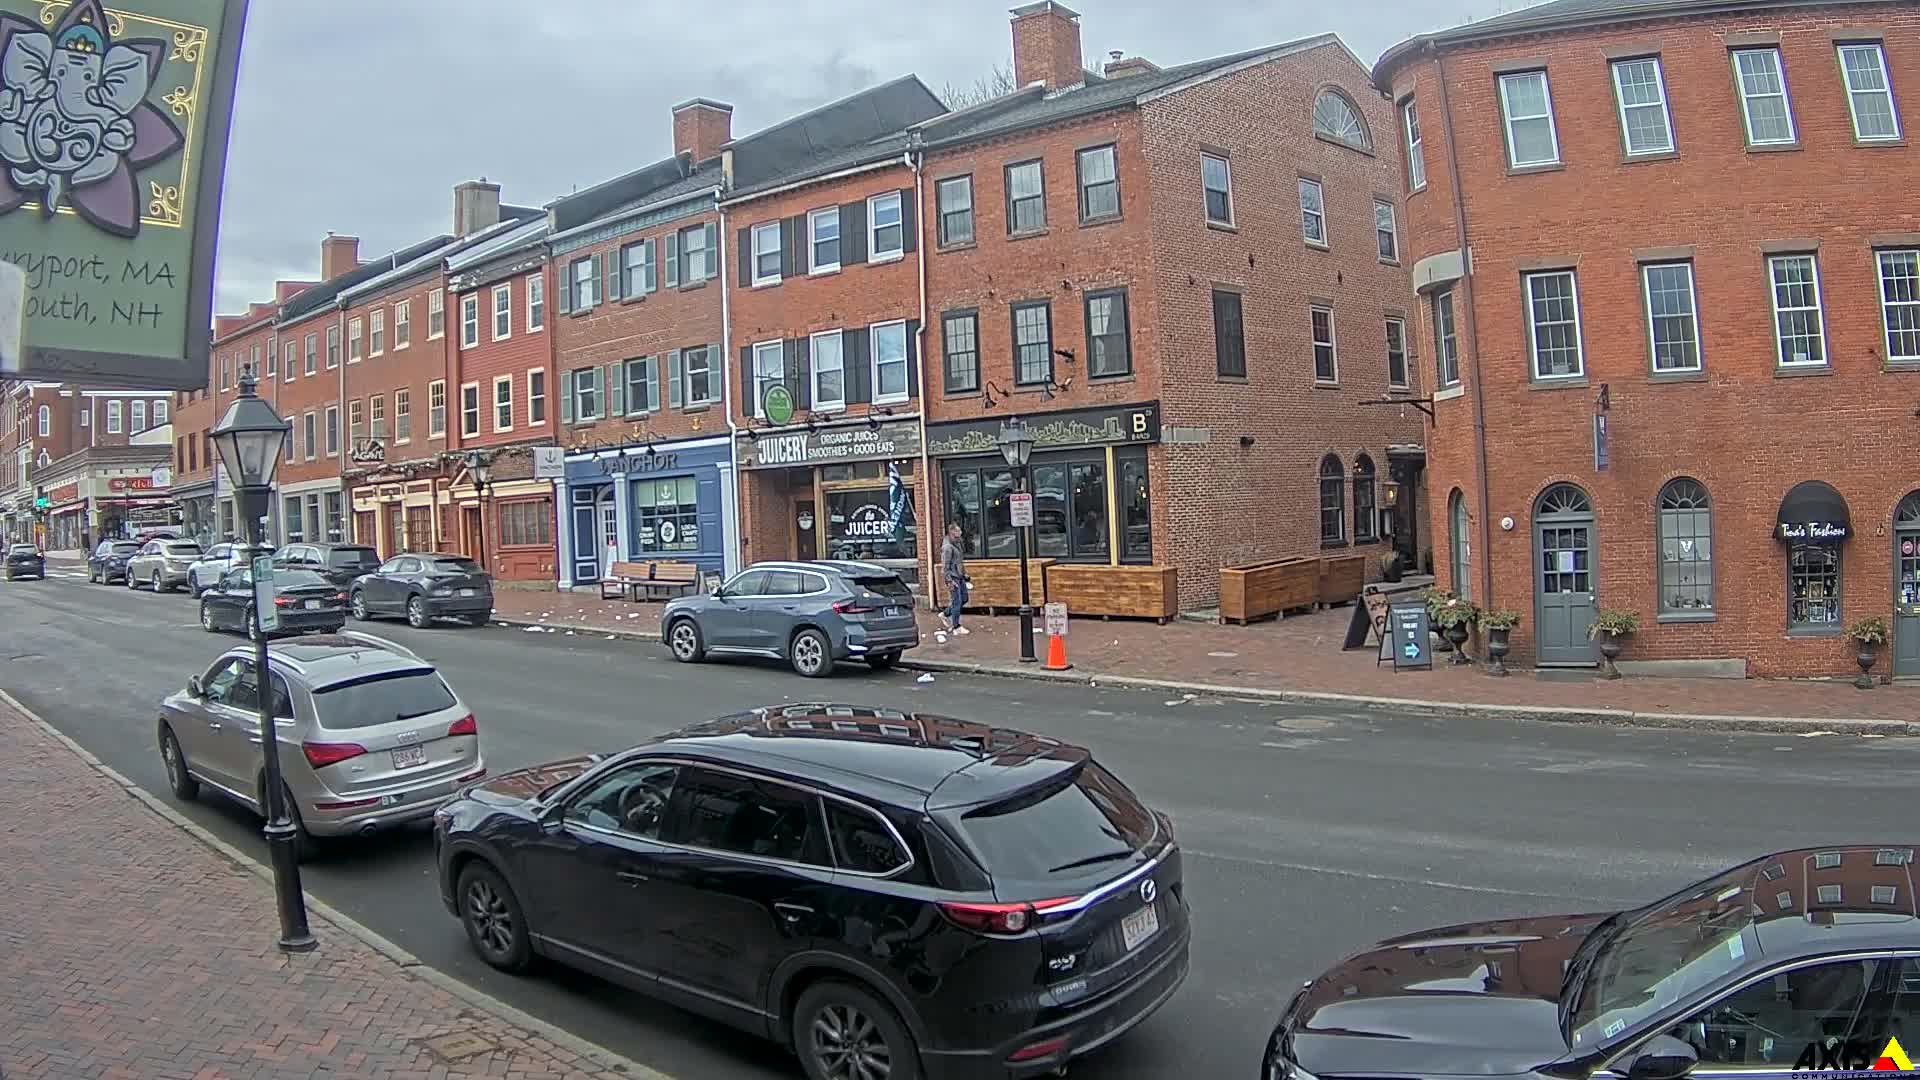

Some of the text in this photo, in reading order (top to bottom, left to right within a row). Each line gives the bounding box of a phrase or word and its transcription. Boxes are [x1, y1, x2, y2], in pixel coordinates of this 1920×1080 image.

[121, 259, 176, 288] MA
[110, 299, 163, 328] NH
[1132, 413, 1147, 433] B
[820, 430, 879, 445] ORGANIC JUICES
[352, 448, 384, 460] AGAVE
[758, 434, 809, 465] JUICERY
[808, 441, 895, 458] SMOOTHIES GOOD EATS
[607, 453, 678, 474] ANCHOR
[1808, 522, 1846, 537] Fashion
